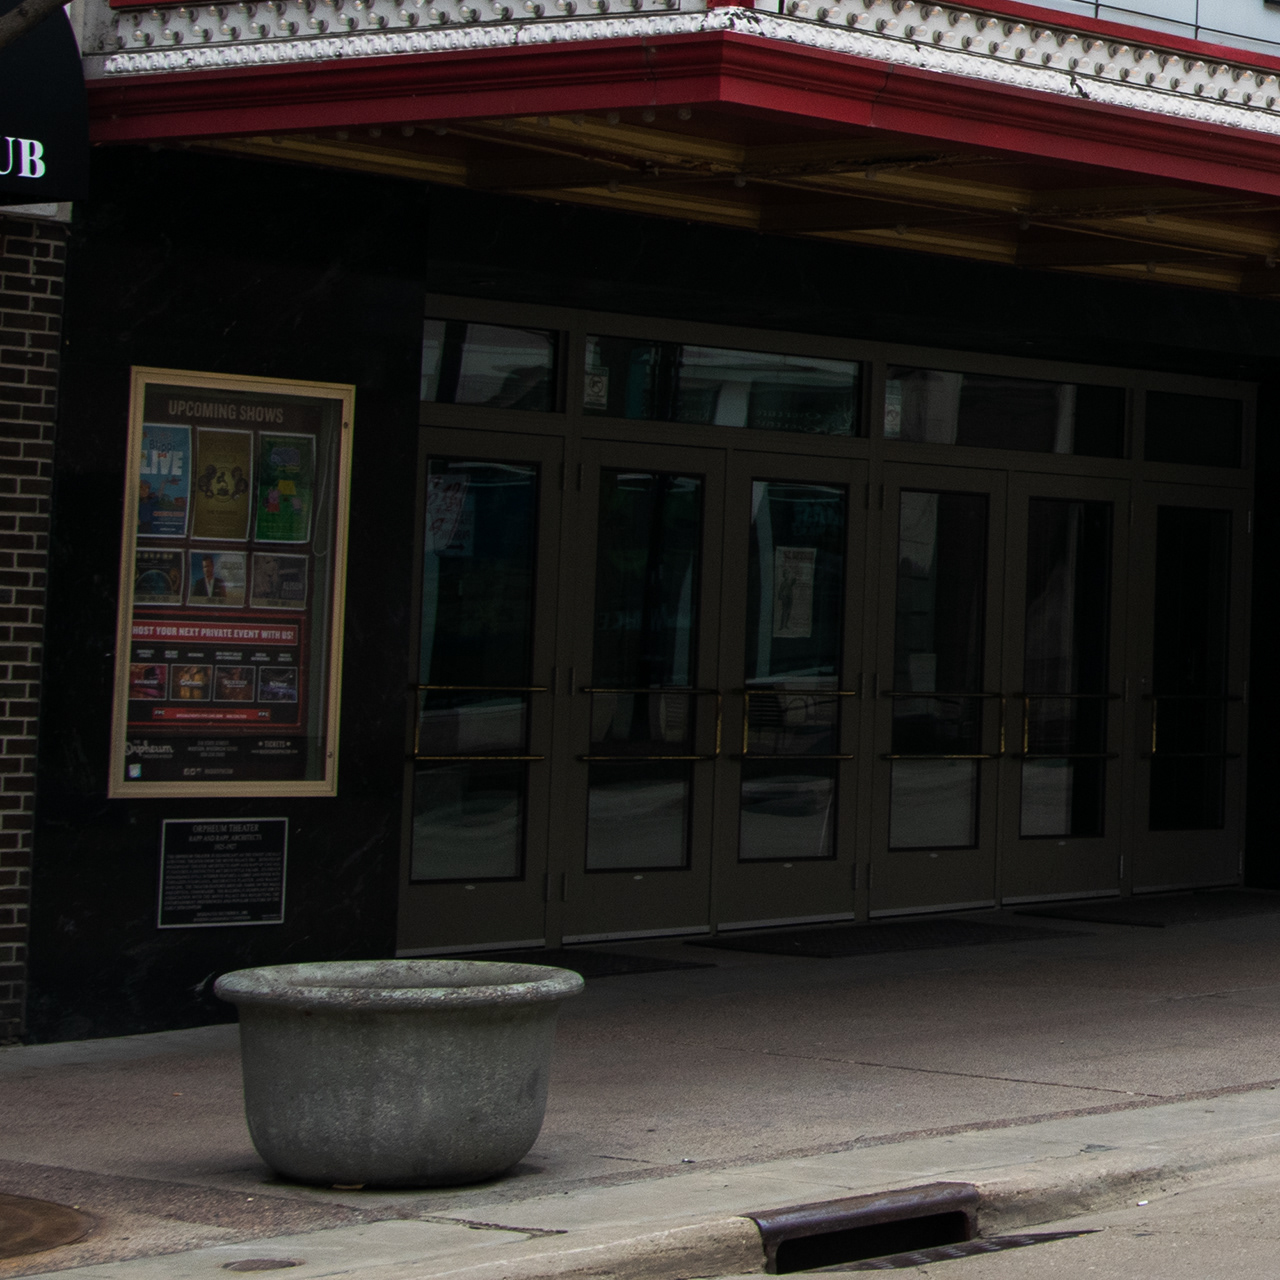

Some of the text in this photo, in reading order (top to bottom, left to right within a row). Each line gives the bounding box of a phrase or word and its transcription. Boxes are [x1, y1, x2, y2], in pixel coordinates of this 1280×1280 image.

[168, 400, 284, 423] UPCOMING SHOWS
[140, 450, 184, 476] LIVE
[133, 626, 294, 639] HOST YOUR NEXT PRIVATE EVENT WITH US!
[192, 823, 260, 833] ORPHEUM THEATER
